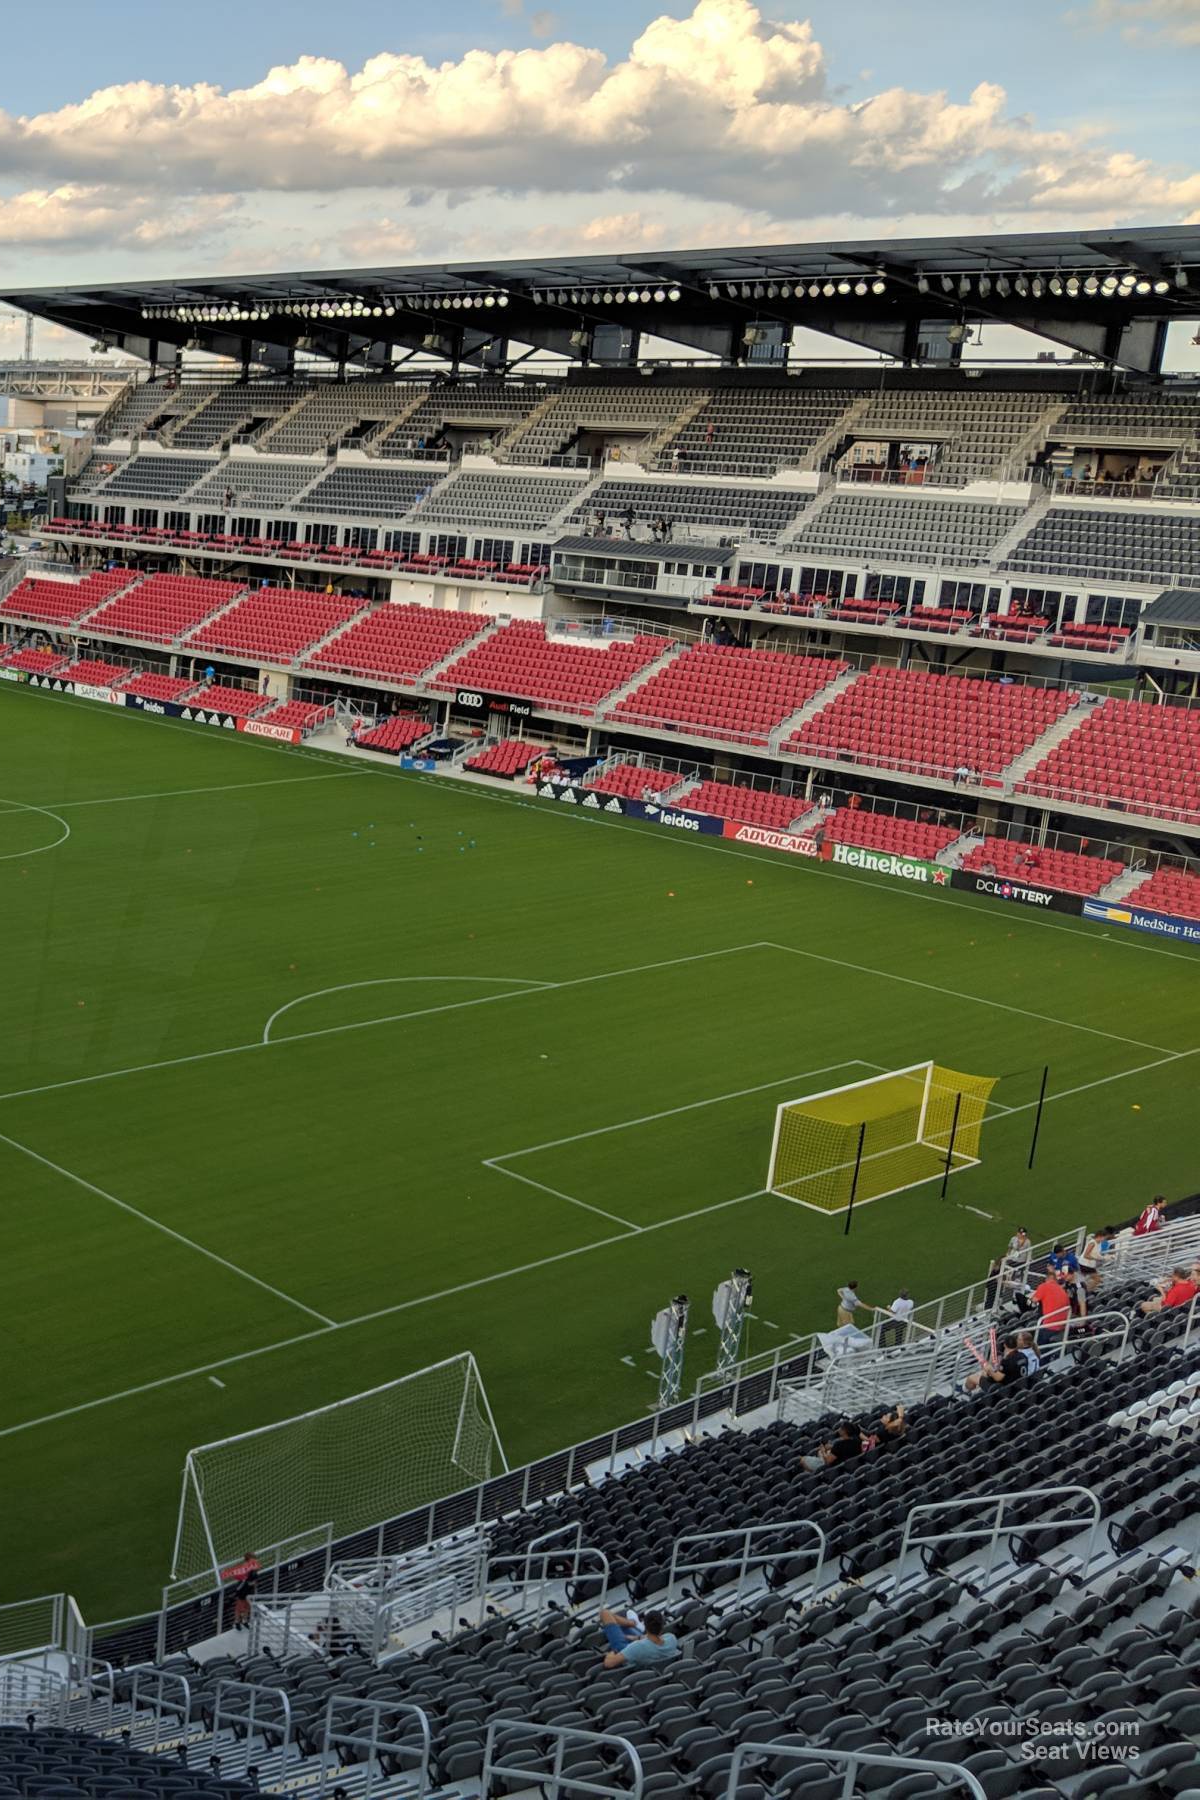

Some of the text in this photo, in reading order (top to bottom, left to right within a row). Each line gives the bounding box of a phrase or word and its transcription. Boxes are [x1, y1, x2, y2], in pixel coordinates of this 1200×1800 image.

[80, 686, 108, 700] SAFEWAY
[143, 700, 165, 715] leidos
[489, 701, 530, 716] Audi Field
[245, 722, 292, 740] ADVOCARE
[659, 810, 700, 831] leidos
[832, 843, 928, 882] Heineken
[1133, 914, 1180, 934] MedStar
